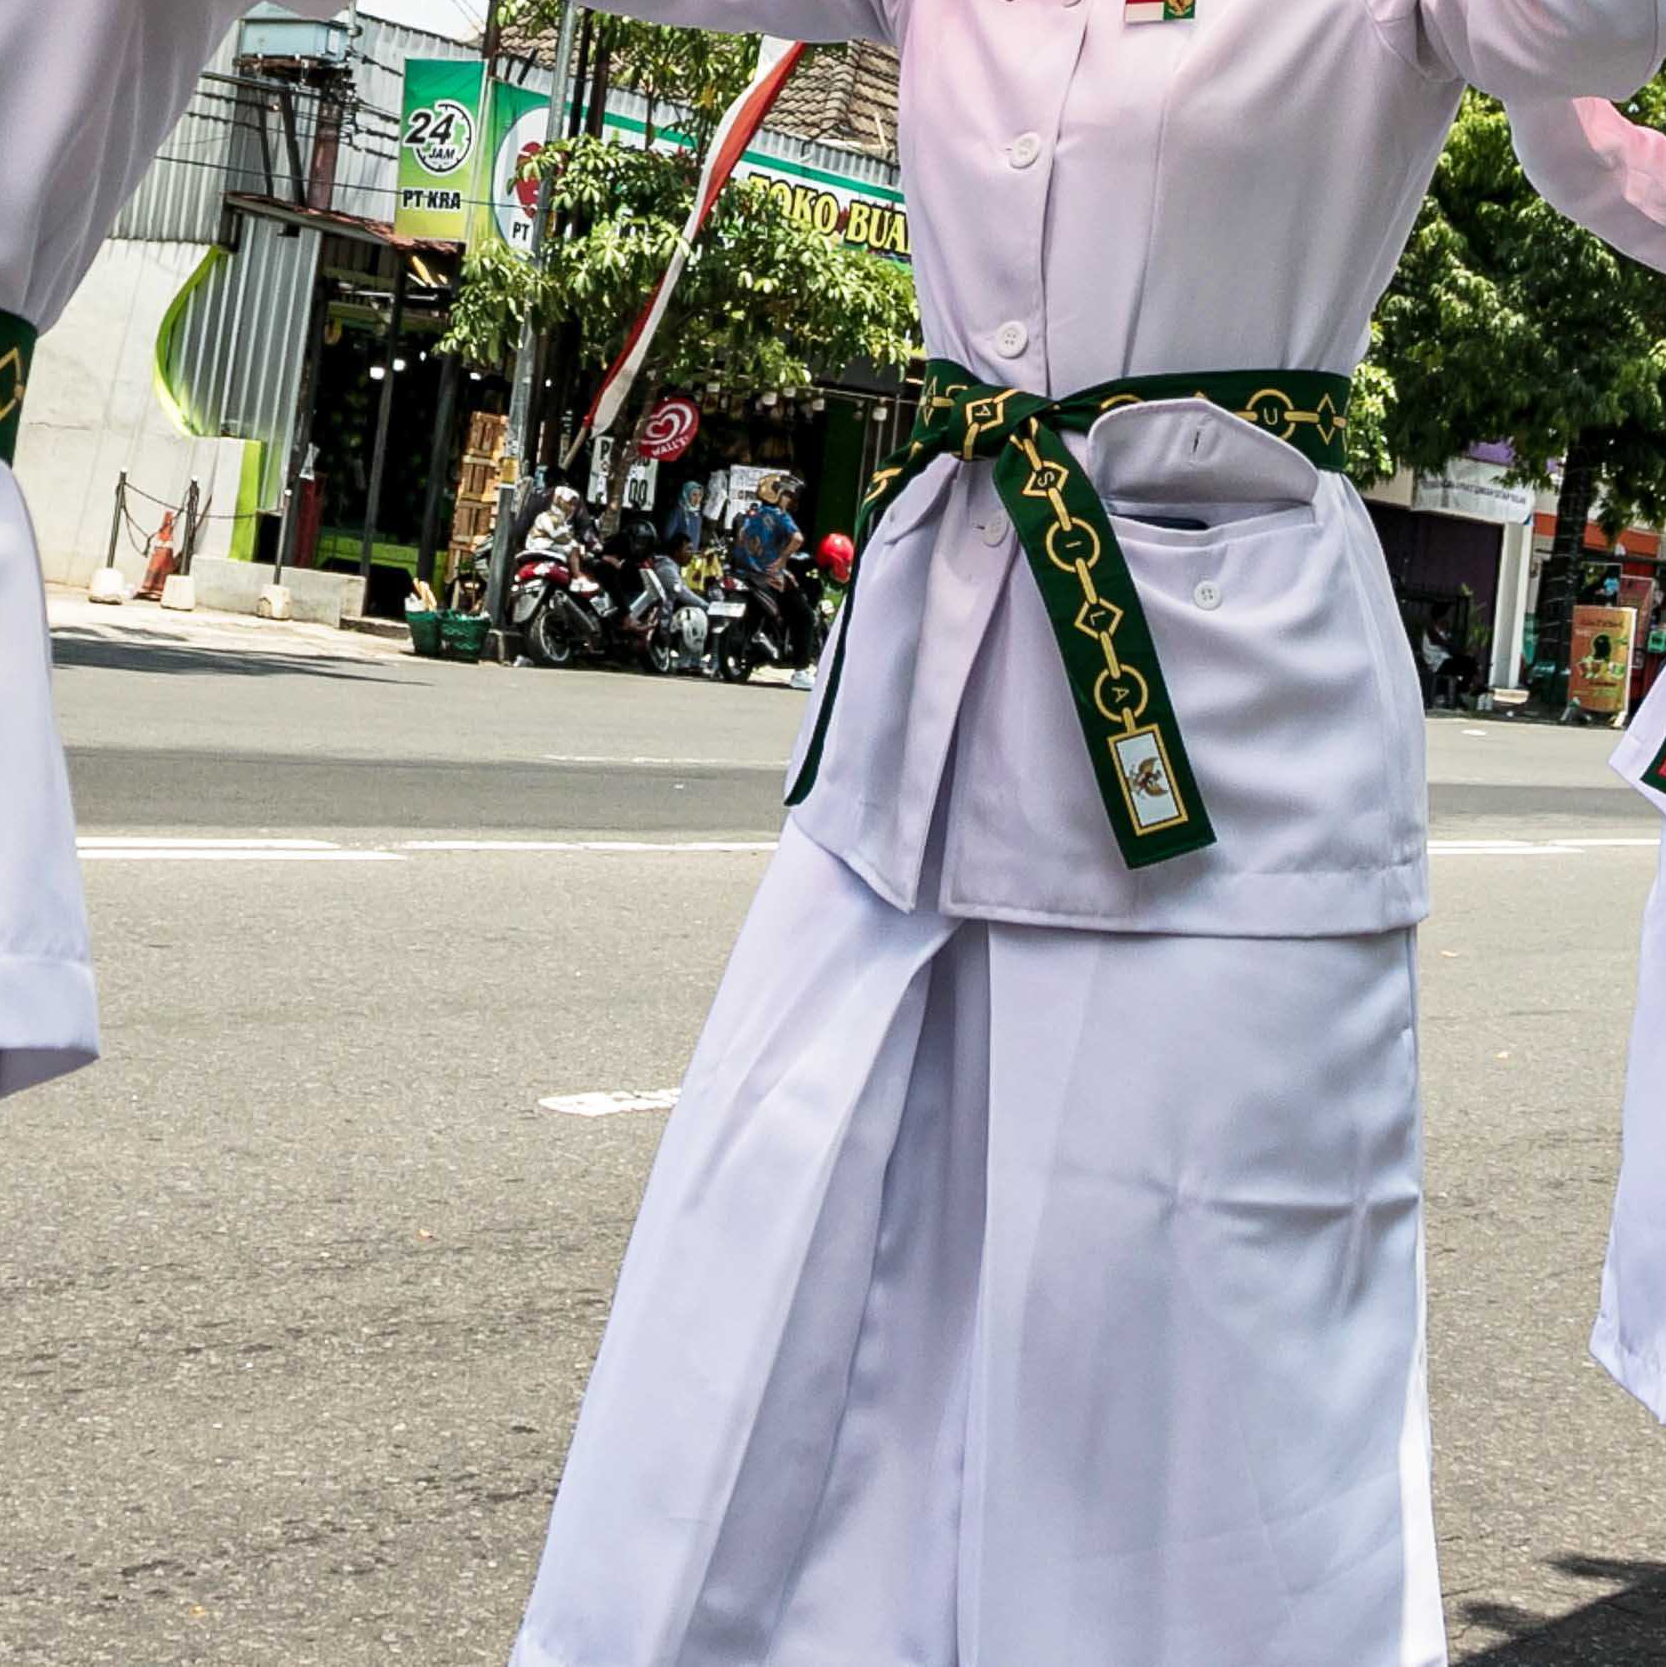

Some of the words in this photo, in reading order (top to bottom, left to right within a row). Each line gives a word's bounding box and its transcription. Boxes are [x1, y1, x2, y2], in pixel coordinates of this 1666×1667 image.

[405, 111, 455, 145] 24
[428, 148, 456, 160] JAM
[402, 189, 425, 208] PT
[427, 190, 461, 210] KRA
[512, 221, 531, 241] PT
[844, 200, 911, 256] BUA
